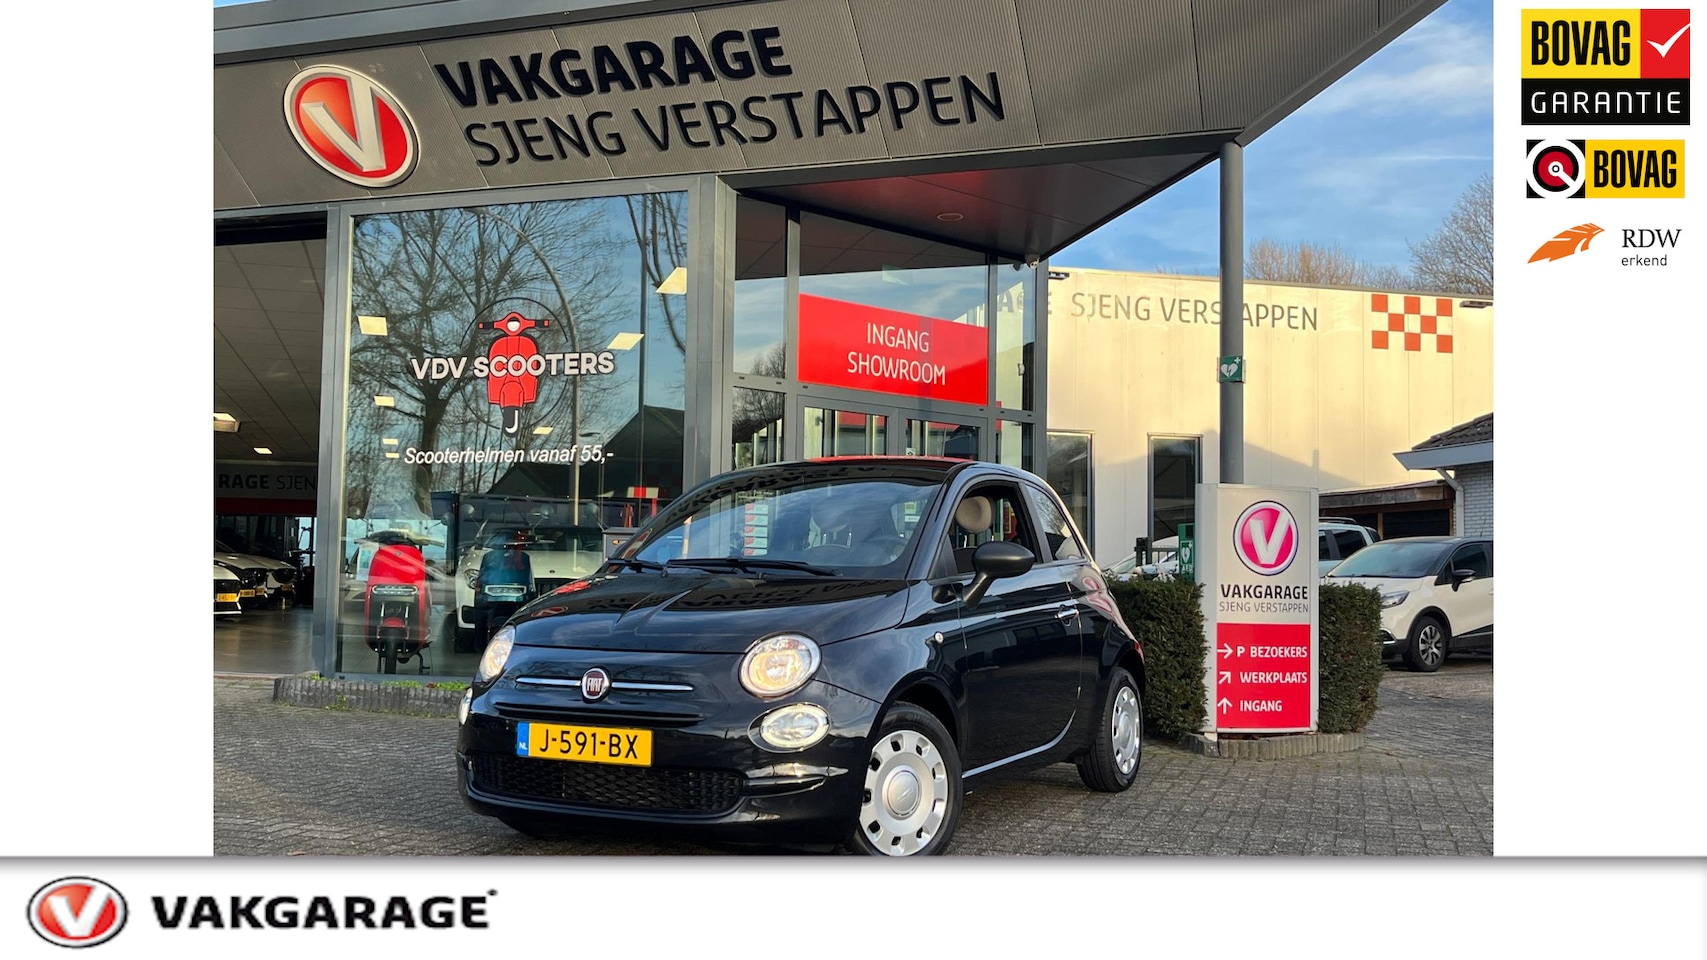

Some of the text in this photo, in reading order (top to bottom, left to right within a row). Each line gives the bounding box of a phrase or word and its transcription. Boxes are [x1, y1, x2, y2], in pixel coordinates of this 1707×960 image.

[434, 26, 793, 108] VAKGARAGE
[465, 71, 1005, 168] SJENG VERSTAPPEN
[1071, 292, 1151, 322] SJENG
[1160, 297, 1317, 331] VERSAPPEN
[866, 322, 930, 354] INGANG
[411, 352, 615, 380] VDV SCOOTERS
[846, 351, 947, 387] SHOWROOM
[404, 444, 614, 466] Scooterhelmen vanaf 55,-
[216, 474, 270, 489] RAGE
[1220, 584, 1309, 600] VAKGARAGE
[1219, 601, 1309, 614] SJENG VERSTAPPEN
[1236, 645, 1308, 659] P BEZOEKERS
[586, 677, 603, 692] FIAT
[1239, 671, 1308, 684] WERKPLAATS
[1239, 699, 1283, 713] INGANG
[519, 742, 527, 750] NL
[539, 729, 639, 760] J-591-BX
